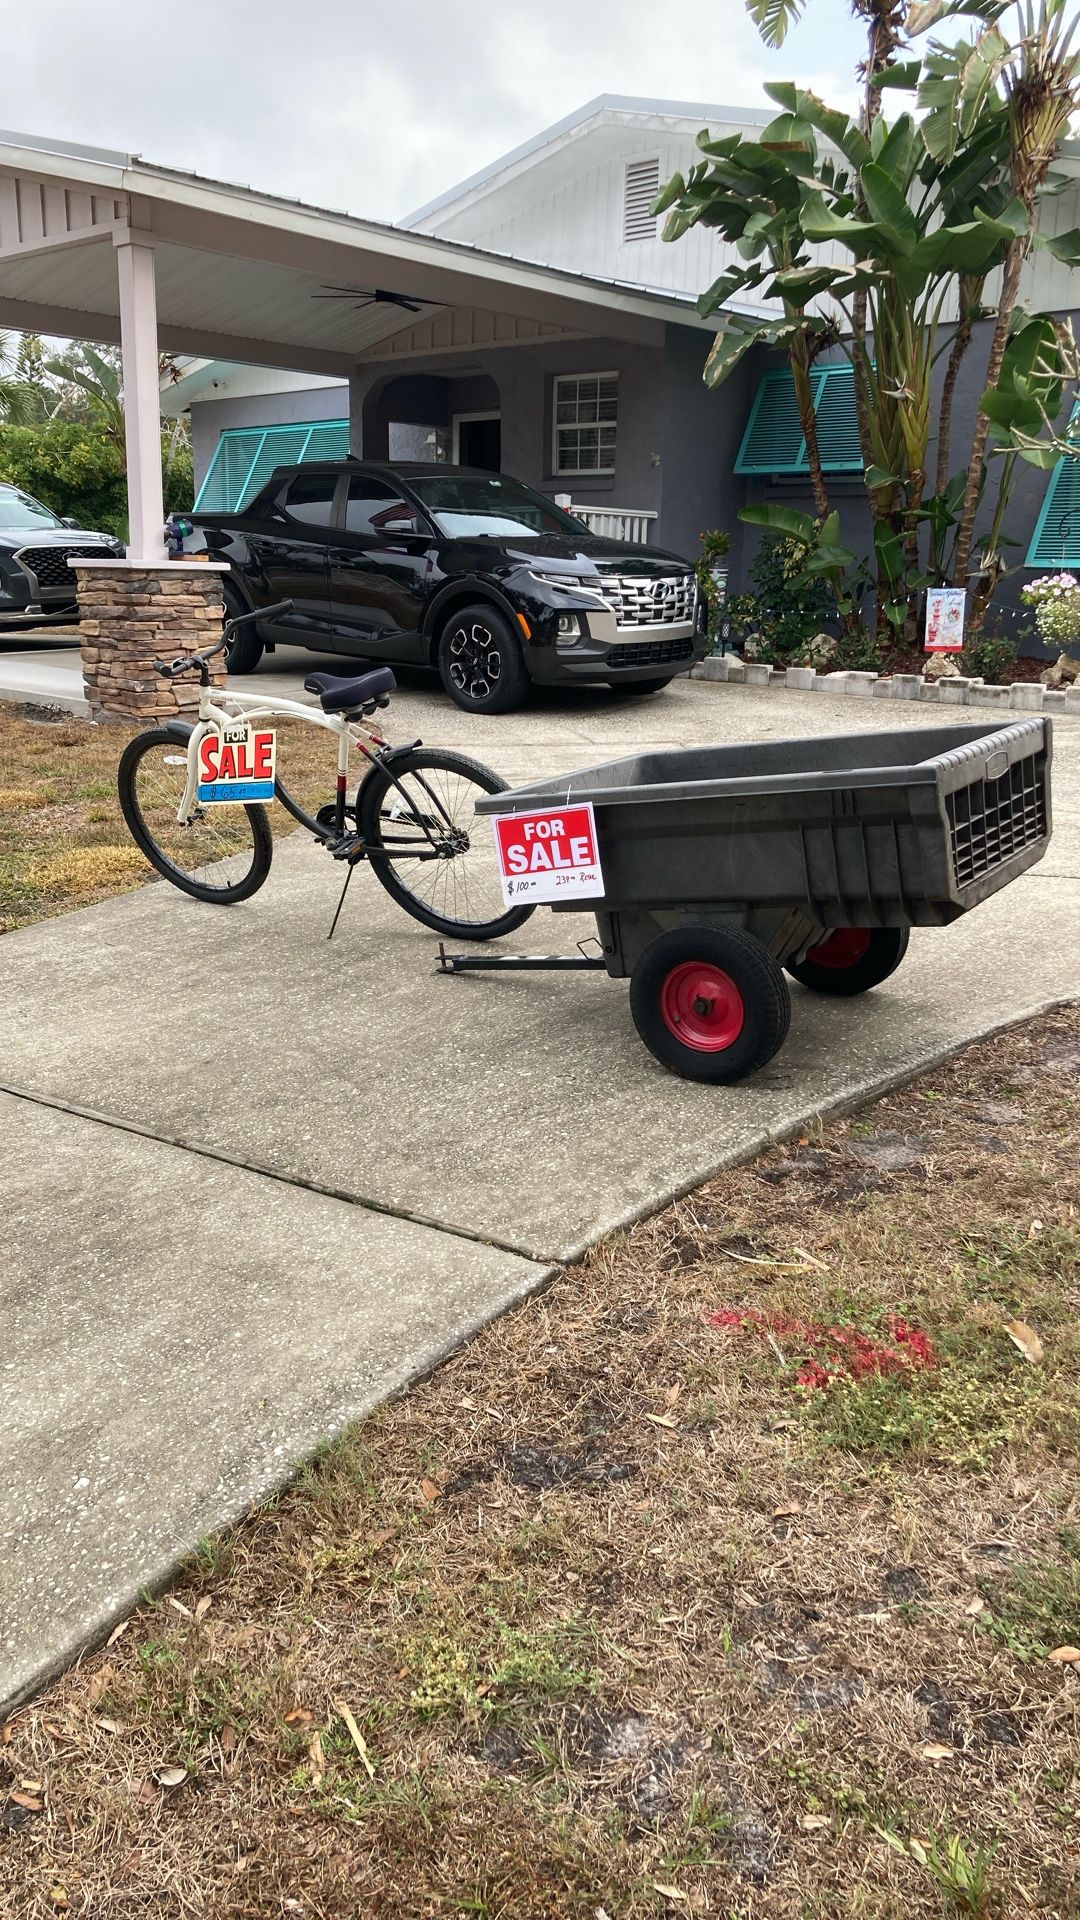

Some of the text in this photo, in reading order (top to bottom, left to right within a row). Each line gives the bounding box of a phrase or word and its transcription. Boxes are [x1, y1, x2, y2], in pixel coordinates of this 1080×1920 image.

[226, 731, 246, 742] FOR
[201, 734, 273, 783] SALE
[523, 819, 565, 840] FOR
[507, 837, 591, 873] SALE
